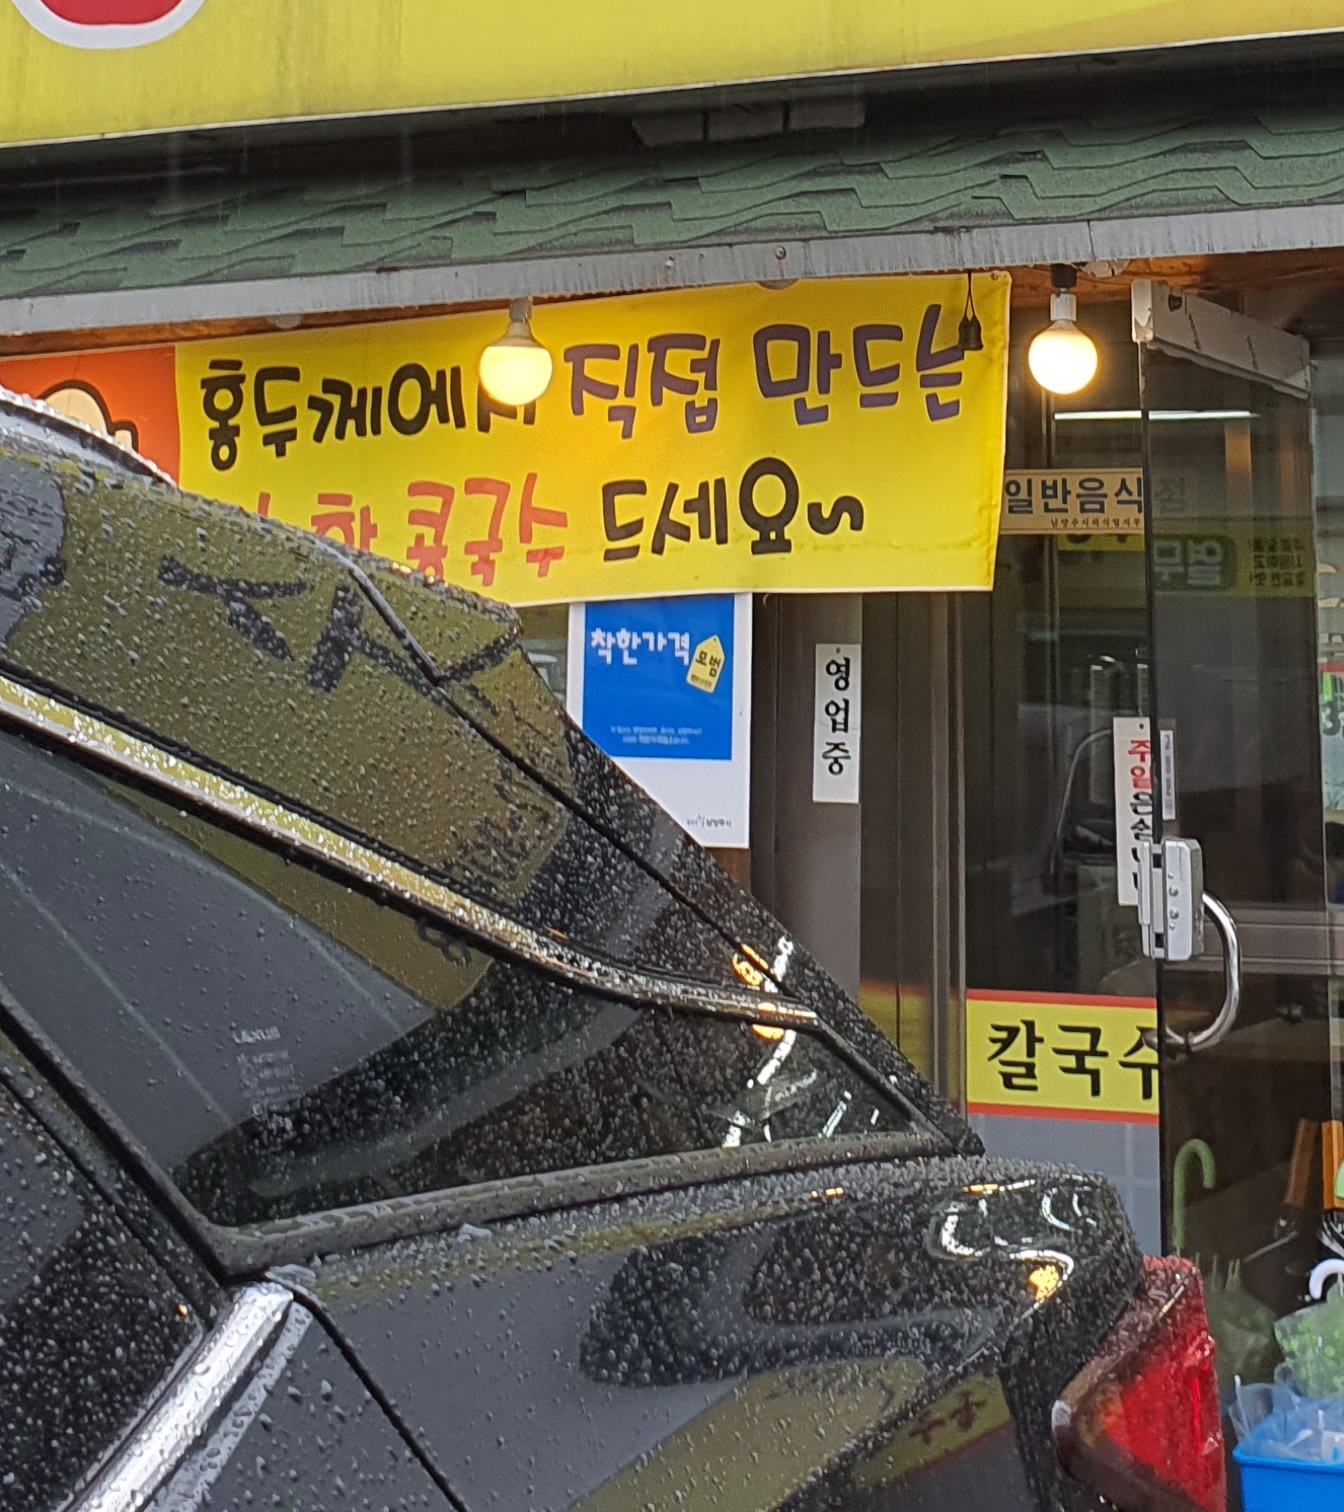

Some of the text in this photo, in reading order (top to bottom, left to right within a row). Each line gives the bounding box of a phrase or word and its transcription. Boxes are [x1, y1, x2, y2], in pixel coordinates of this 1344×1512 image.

[563, 333, 721, 440] 직접
[752, 303, 965, 423] 만드는
[406, 472, 569, 587] 콩국수
[1004, 476, 1186, 516] 일반음식
[590, 627, 690, 666] 착한가격
[695, 650, 723, 679] 모범
[821, 656, 853, 776] 영업중
[986, 1019, 1160, 1101] 칼국수
